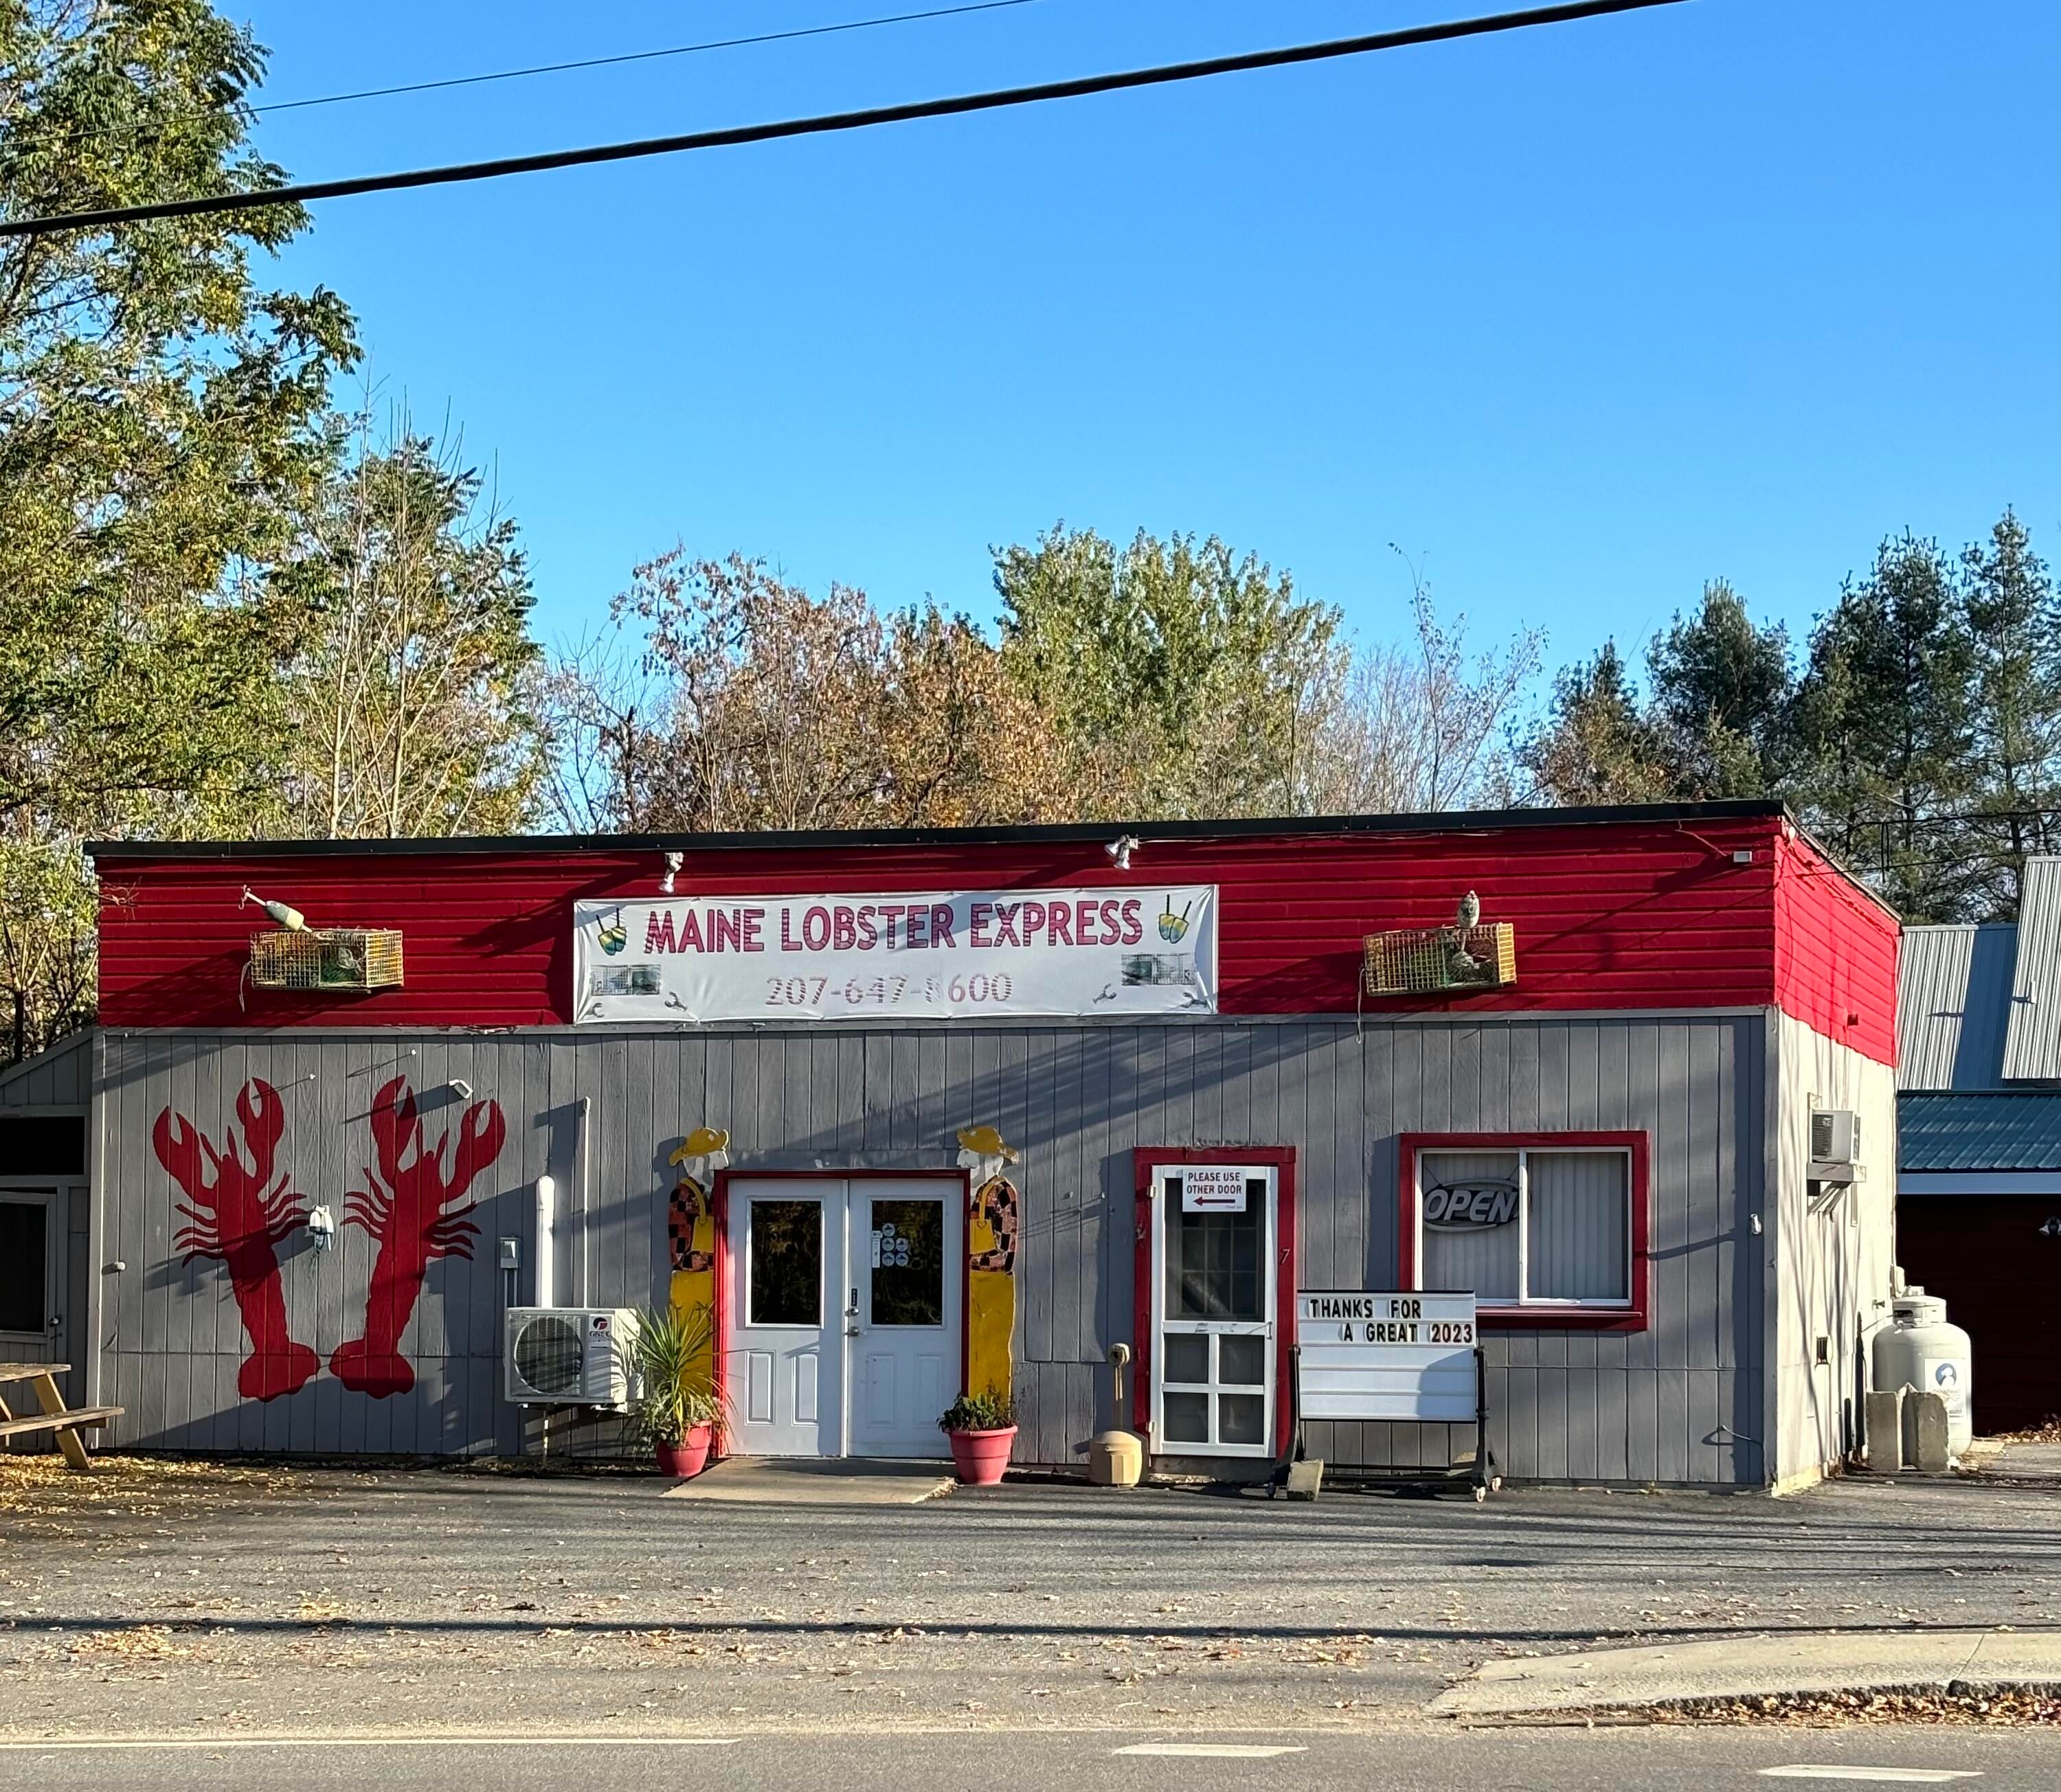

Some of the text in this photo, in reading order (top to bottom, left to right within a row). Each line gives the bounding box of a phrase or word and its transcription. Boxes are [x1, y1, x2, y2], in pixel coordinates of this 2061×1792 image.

[644, 900, 1143, 953] MAINE LOBSTER EXPRESS
[1188, 1172, 1241, 1182] PLEASE USE
[1186, 1185, 1242, 1194] OTHER DOOR
[1424, 1189, 1518, 1223] OPEN
[1309, 1299, 1421, 1319] THANKS FOR
[1343, 1323, 1472, 1343] A GREAT 2023
